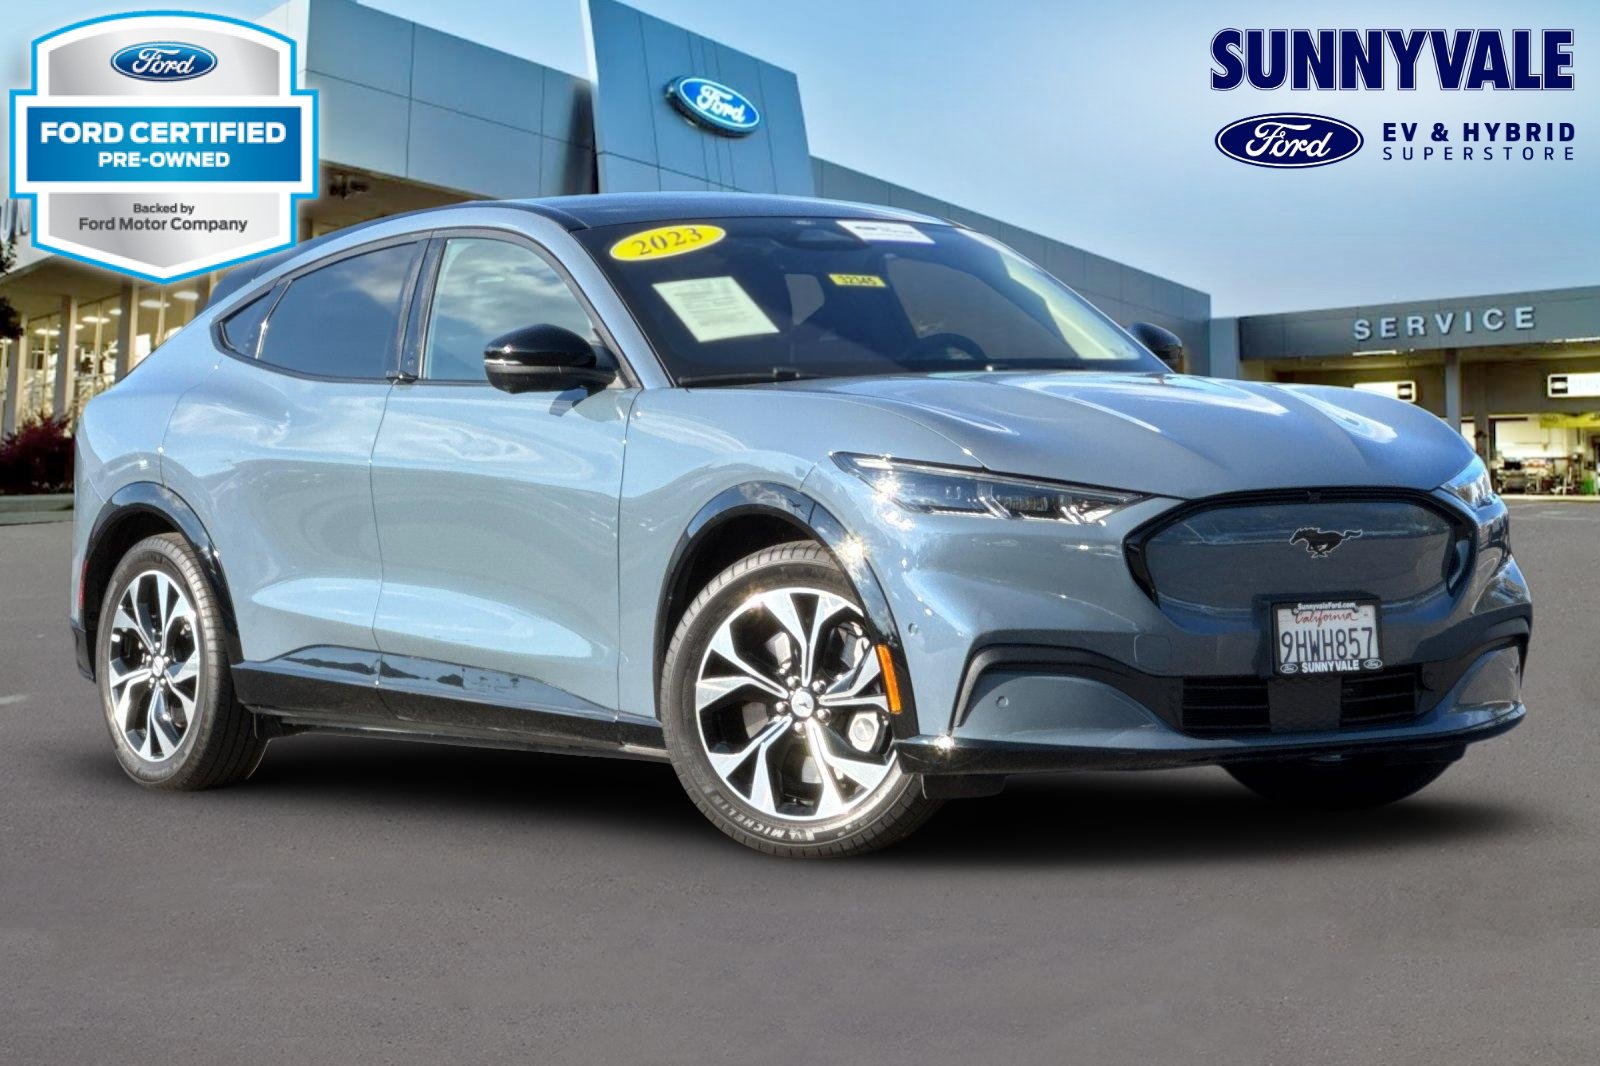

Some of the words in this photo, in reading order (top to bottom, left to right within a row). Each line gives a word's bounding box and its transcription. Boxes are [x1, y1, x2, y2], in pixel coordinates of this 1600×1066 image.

[696, 85, 746, 123] Ford
[631, 226, 704, 256] 2023
[1353, 306, 1536, 341] SERVICE
[1294, 609, 1360, 626] California
[1281, 627, 1373, 662] 9HWH857
[1301, 660, 1360, 673] SUNNYVALE
